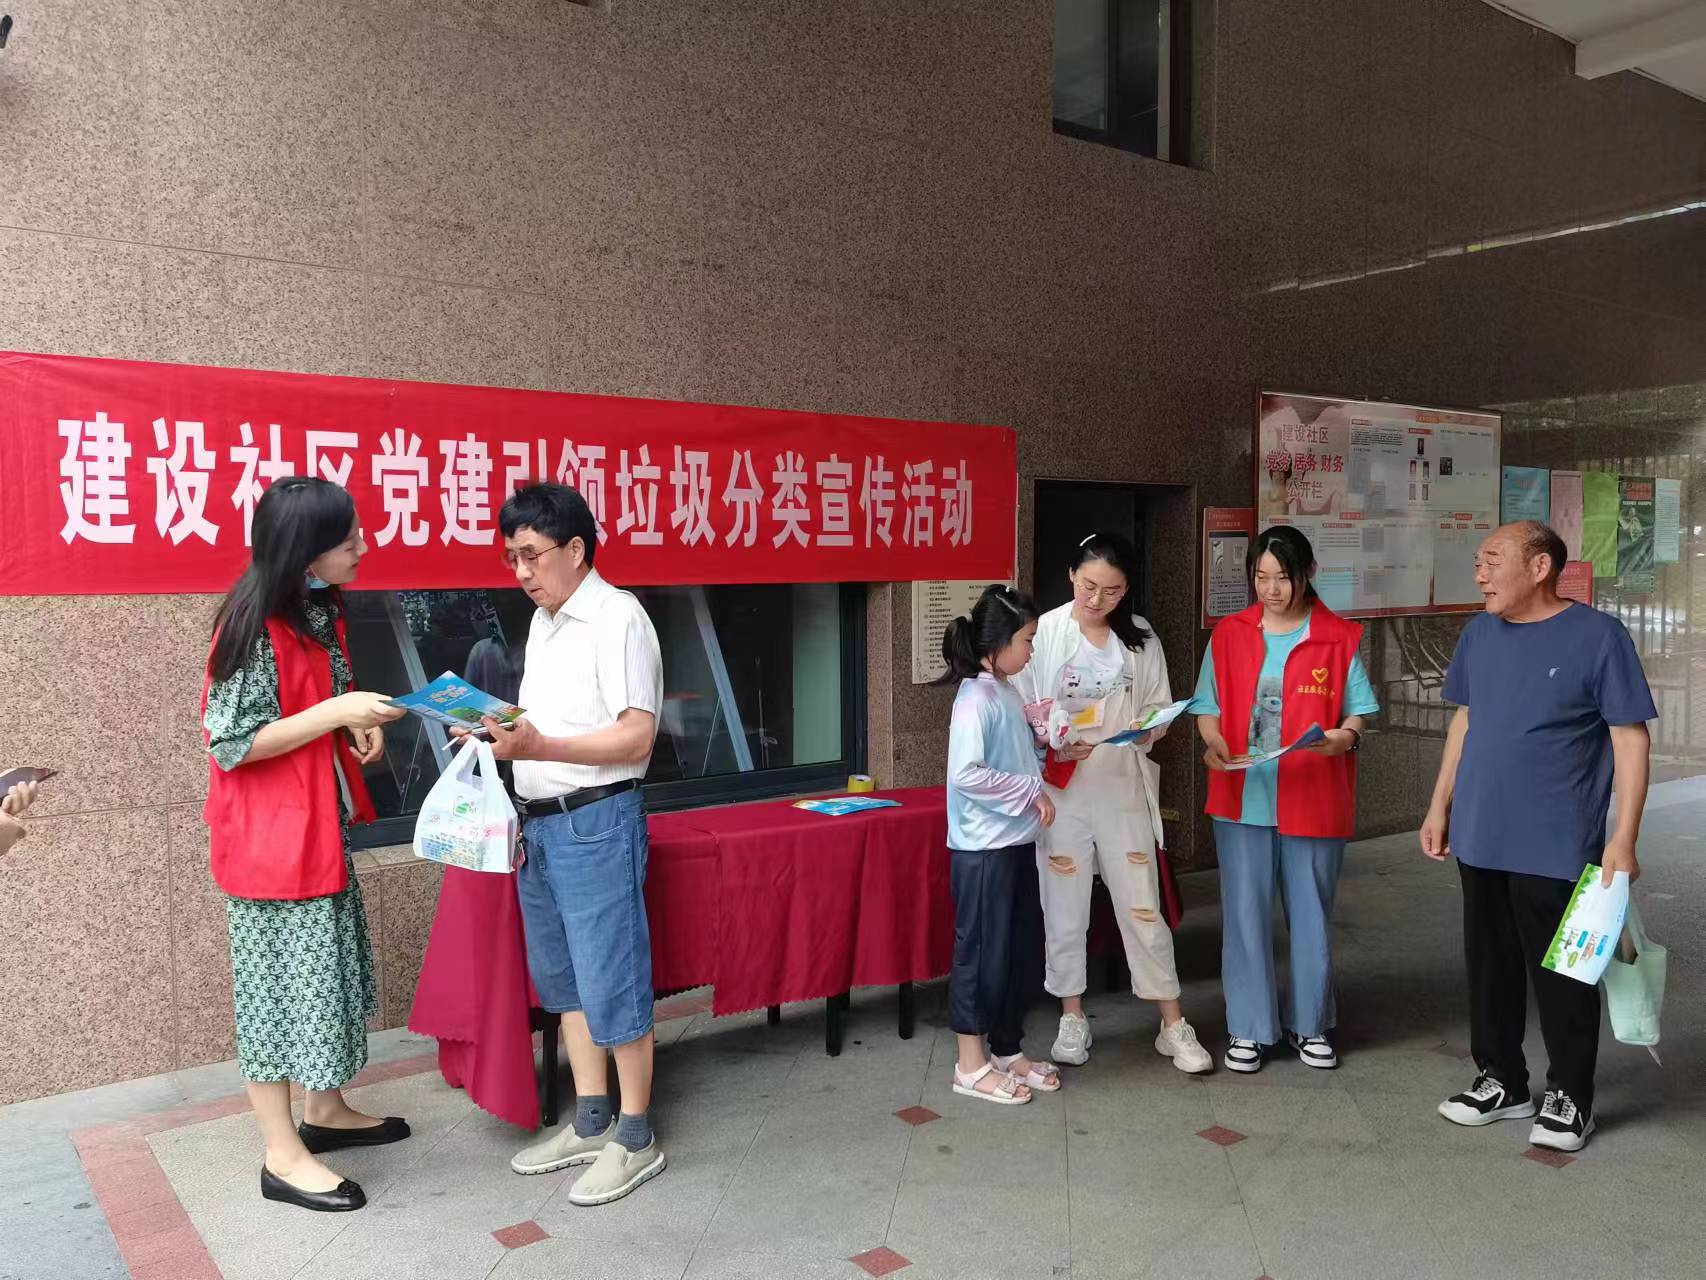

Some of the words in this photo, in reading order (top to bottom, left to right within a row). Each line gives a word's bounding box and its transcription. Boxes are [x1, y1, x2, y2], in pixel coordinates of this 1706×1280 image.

[1281, 424, 1329, 443] 建设社区
[1287, 480, 1323, 499] 公开栏
